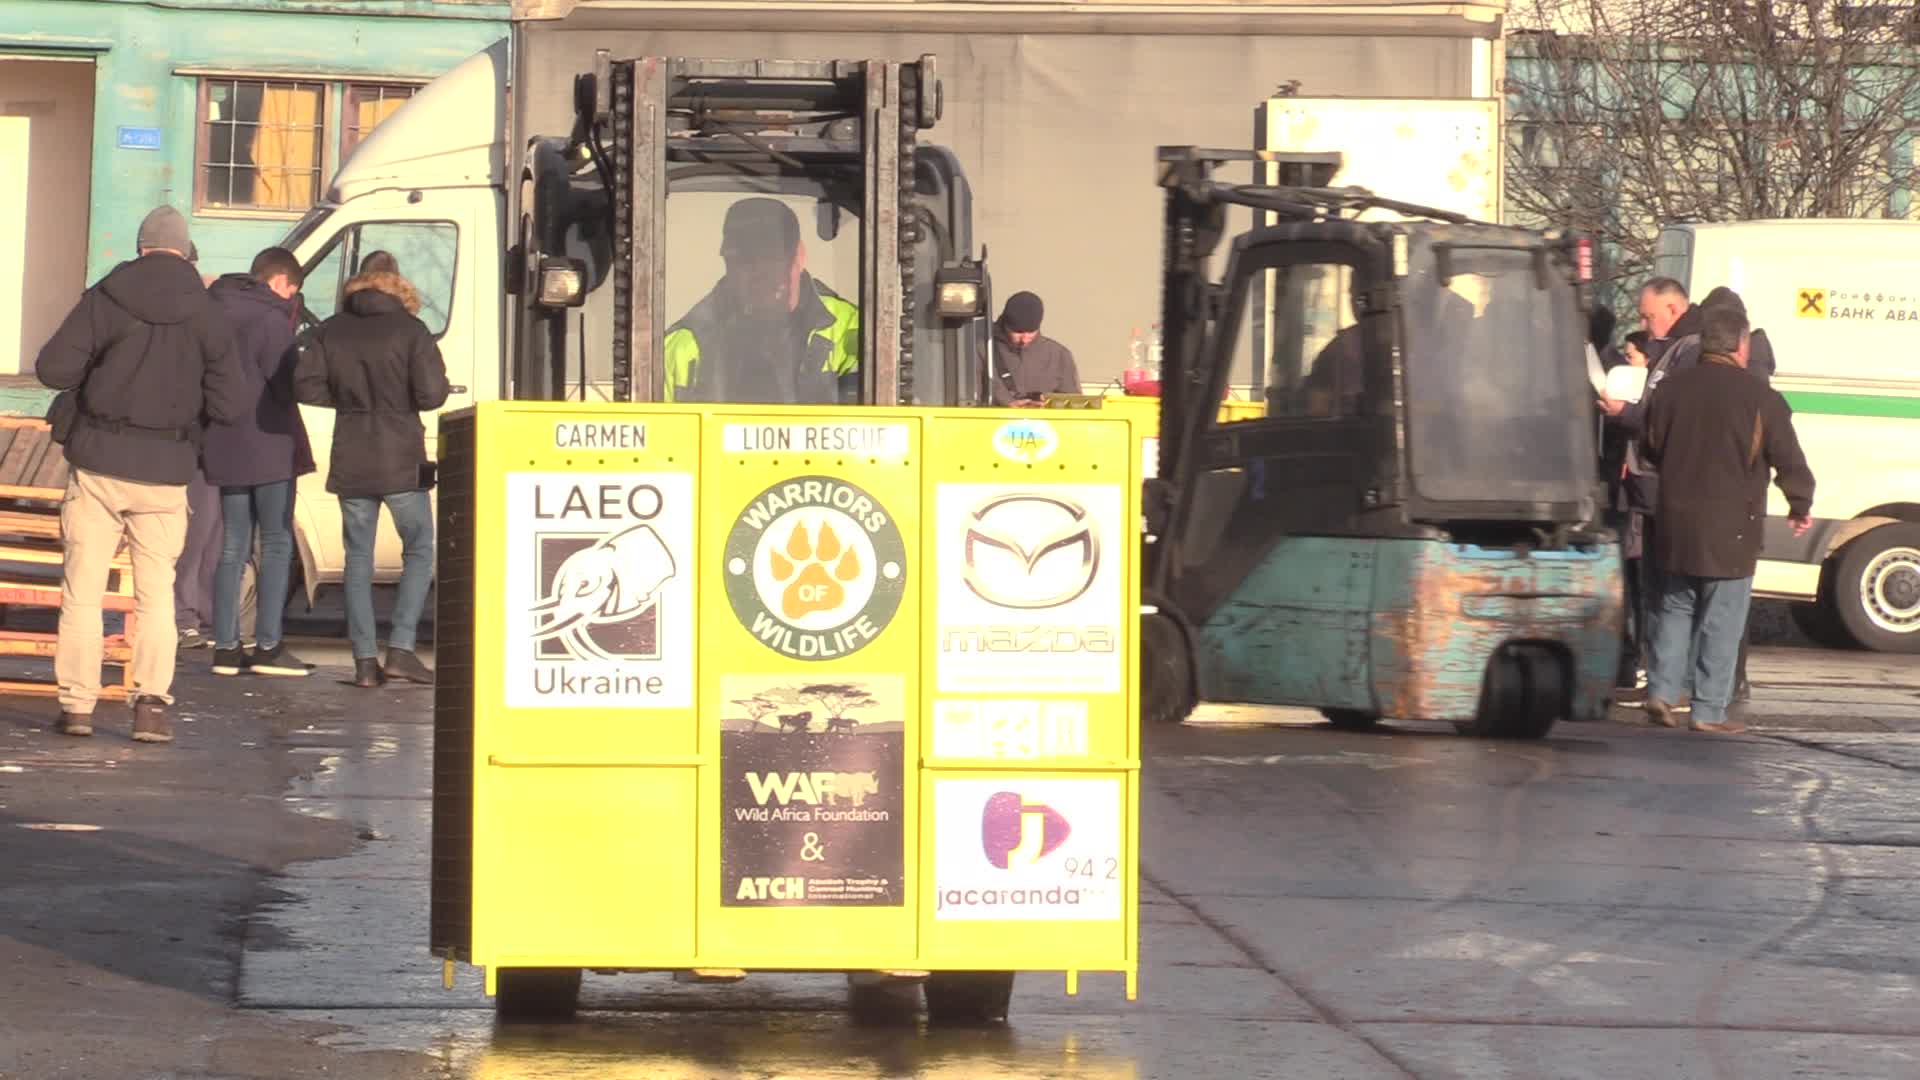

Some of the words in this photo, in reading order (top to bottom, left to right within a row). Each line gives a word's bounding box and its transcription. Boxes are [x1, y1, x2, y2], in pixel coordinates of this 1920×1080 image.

[1830, 306, 1875, 319] БАНК
[555, 424, 646, 448] CARMEN
[743, 427, 791, 450] LION
[1011, 431, 1037, 449] UA
[534, 484, 664, 520] LAEO
[742, 481, 887, 533] WARRIORS
[798, 584, 829, 602] OF
[751, 611, 879, 657] WILDLIFE
[534, 665, 664, 695] Ukraine
[735, 807, 768, 822] Wild
[771, 807, 810, 822] Africa
[814, 807, 889, 822] Foundation
[800, 832, 825, 861] &
[736, 877, 805, 900] ATCH
[937, 886, 1081, 911] jacaranda
